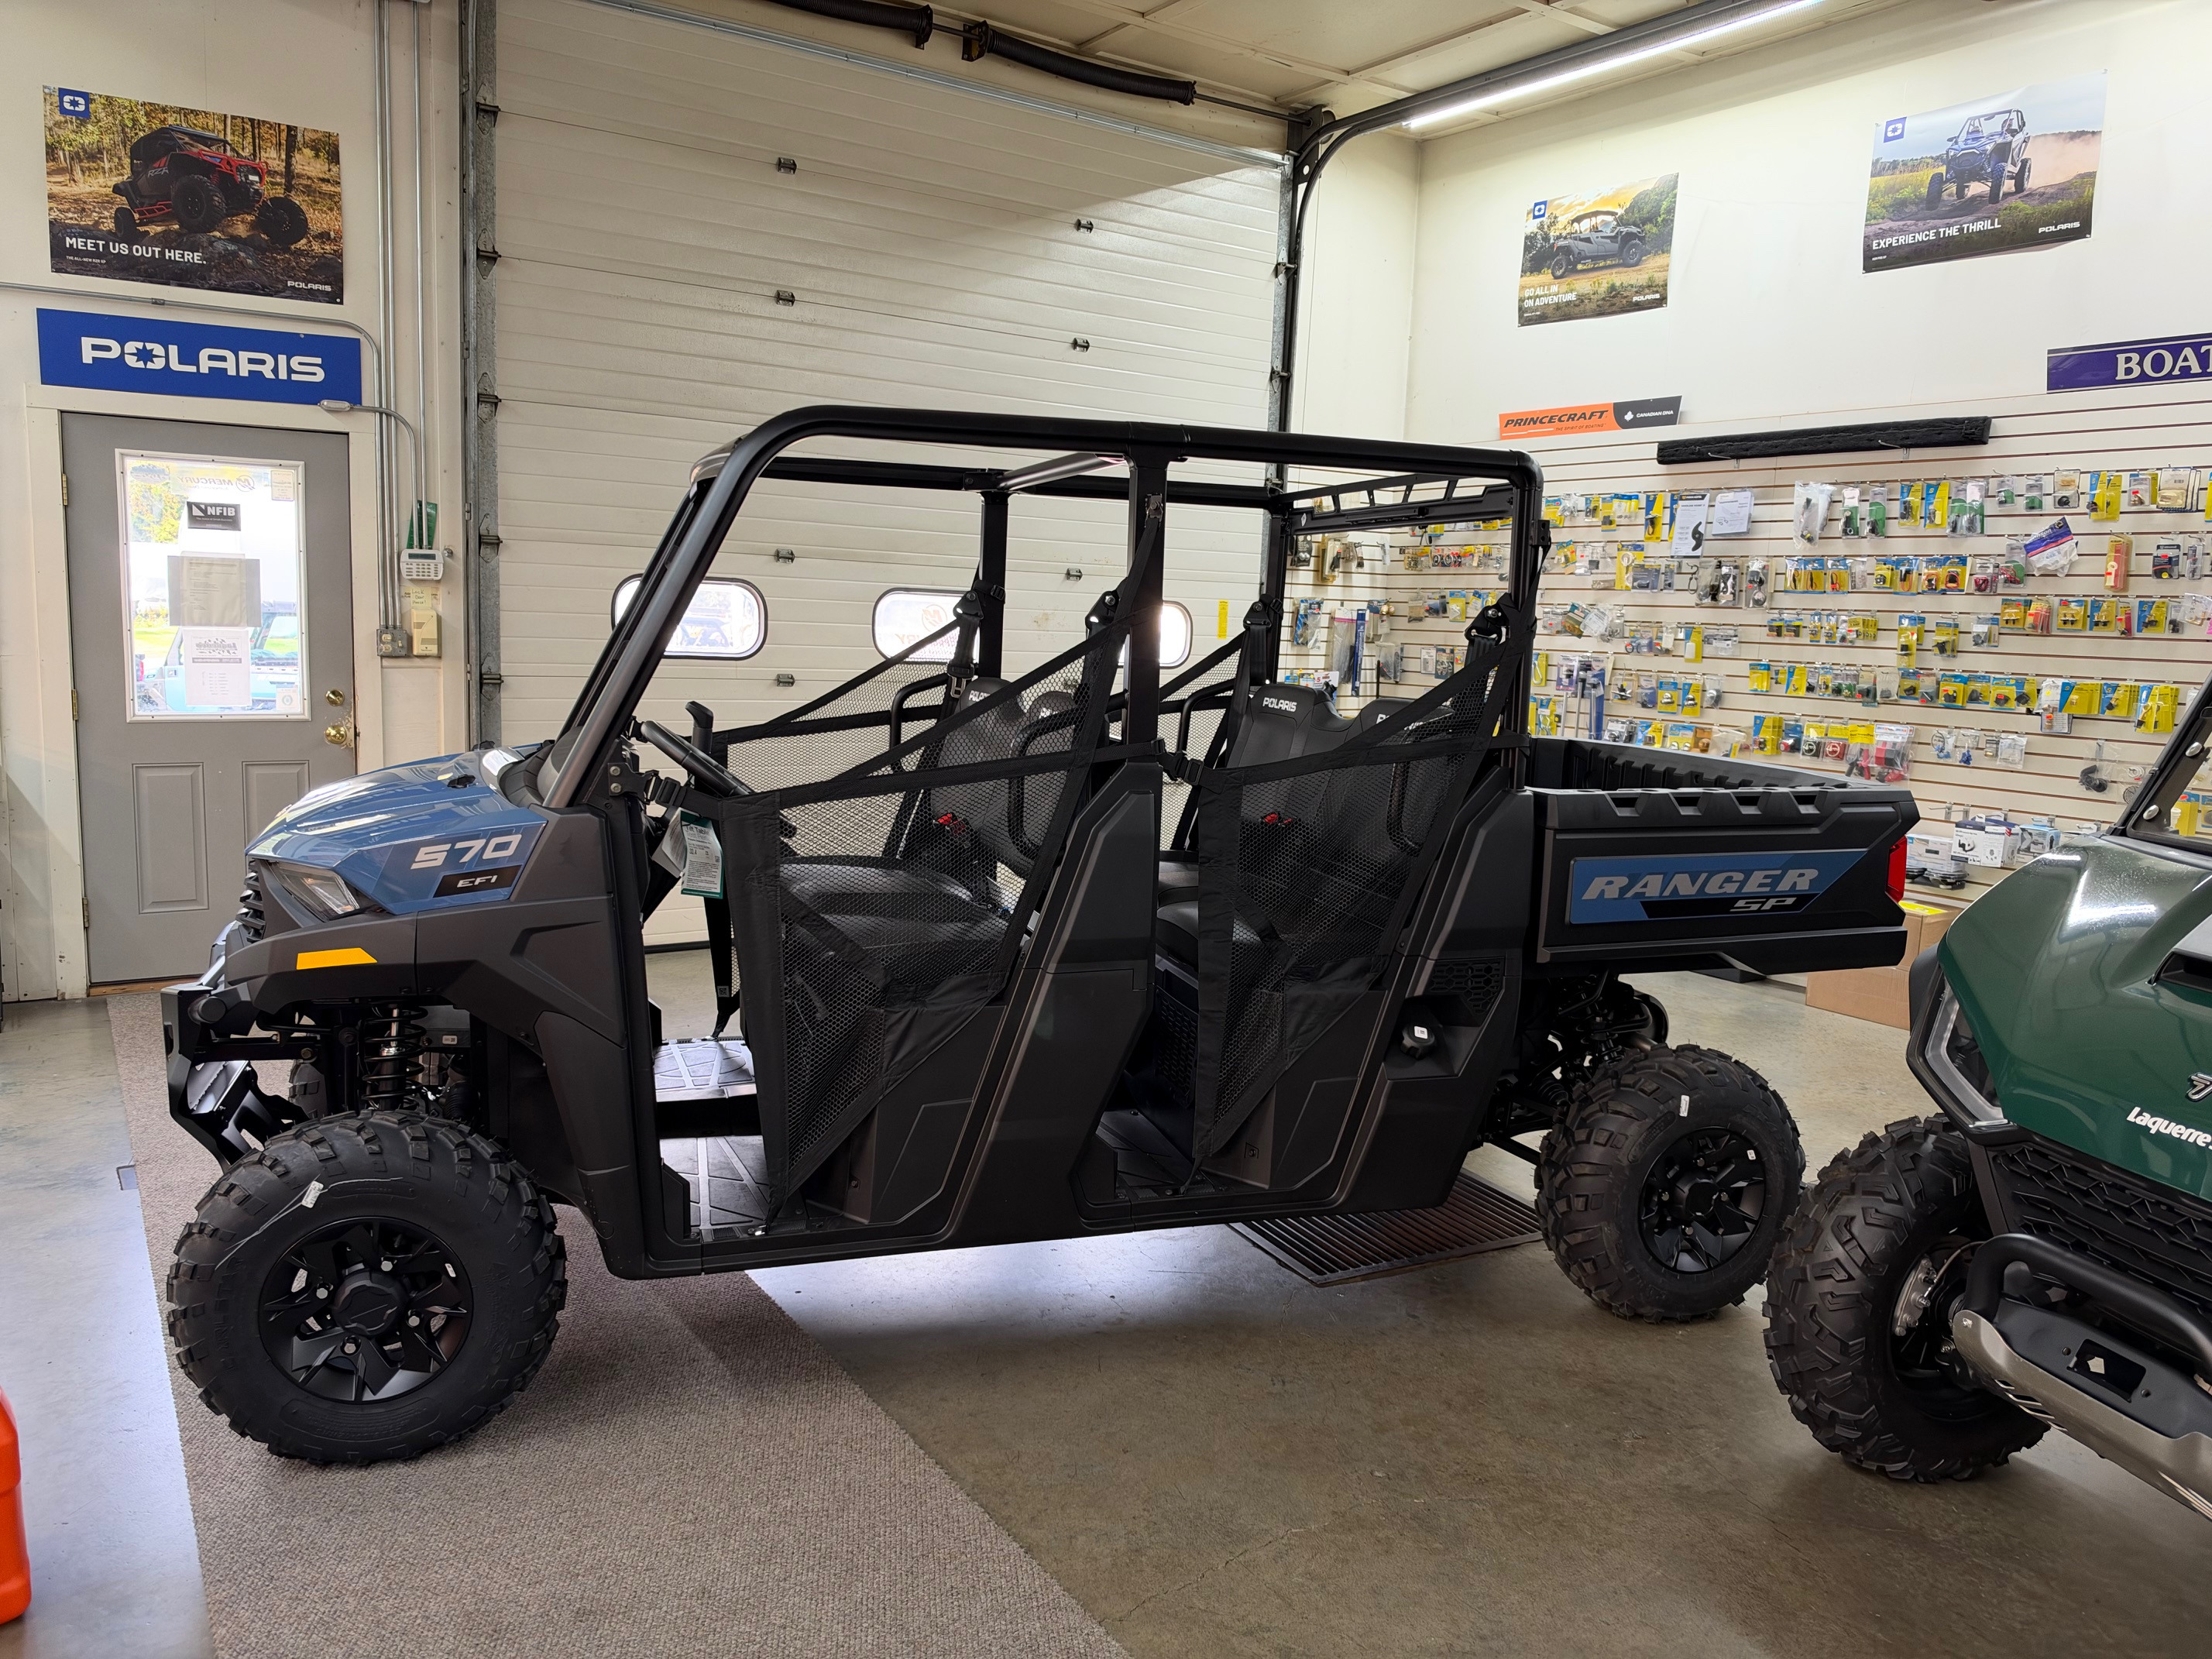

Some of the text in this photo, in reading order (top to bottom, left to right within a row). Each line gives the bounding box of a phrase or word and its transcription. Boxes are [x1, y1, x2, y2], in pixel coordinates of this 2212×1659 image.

[1872, 218, 2002, 249] EXPERIENCE THE THRILL
[2038, 221, 2081, 234] POLARIS
[65, 236, 207, 265] MEET US OUT HERE.
[287, 280, 332, 292] POLARIS
[1524, 283, 1558, 297] GO ALL IN
[1523, 292, 1578, 308] ON ADVENTURE
[1633, 293, 1661, 302] POLARIS
[80, 335, 326, 383] POLARIS
[1503, 410, 1609, 428] PRINCECRAFT
[207, 506, 235, 517] NFIB
[968, 689, 991, 702] POLA
[1262, 697, 1297, 713] POLARIS
[410, 833, 523, 870] 570
[456, 874, 499, 888] EFI
[1581, 867, 1819, 900] RANGER
[1729, 896, 1798, 912] SP
[2126, 1106, 2212, 1150] Laquerre
